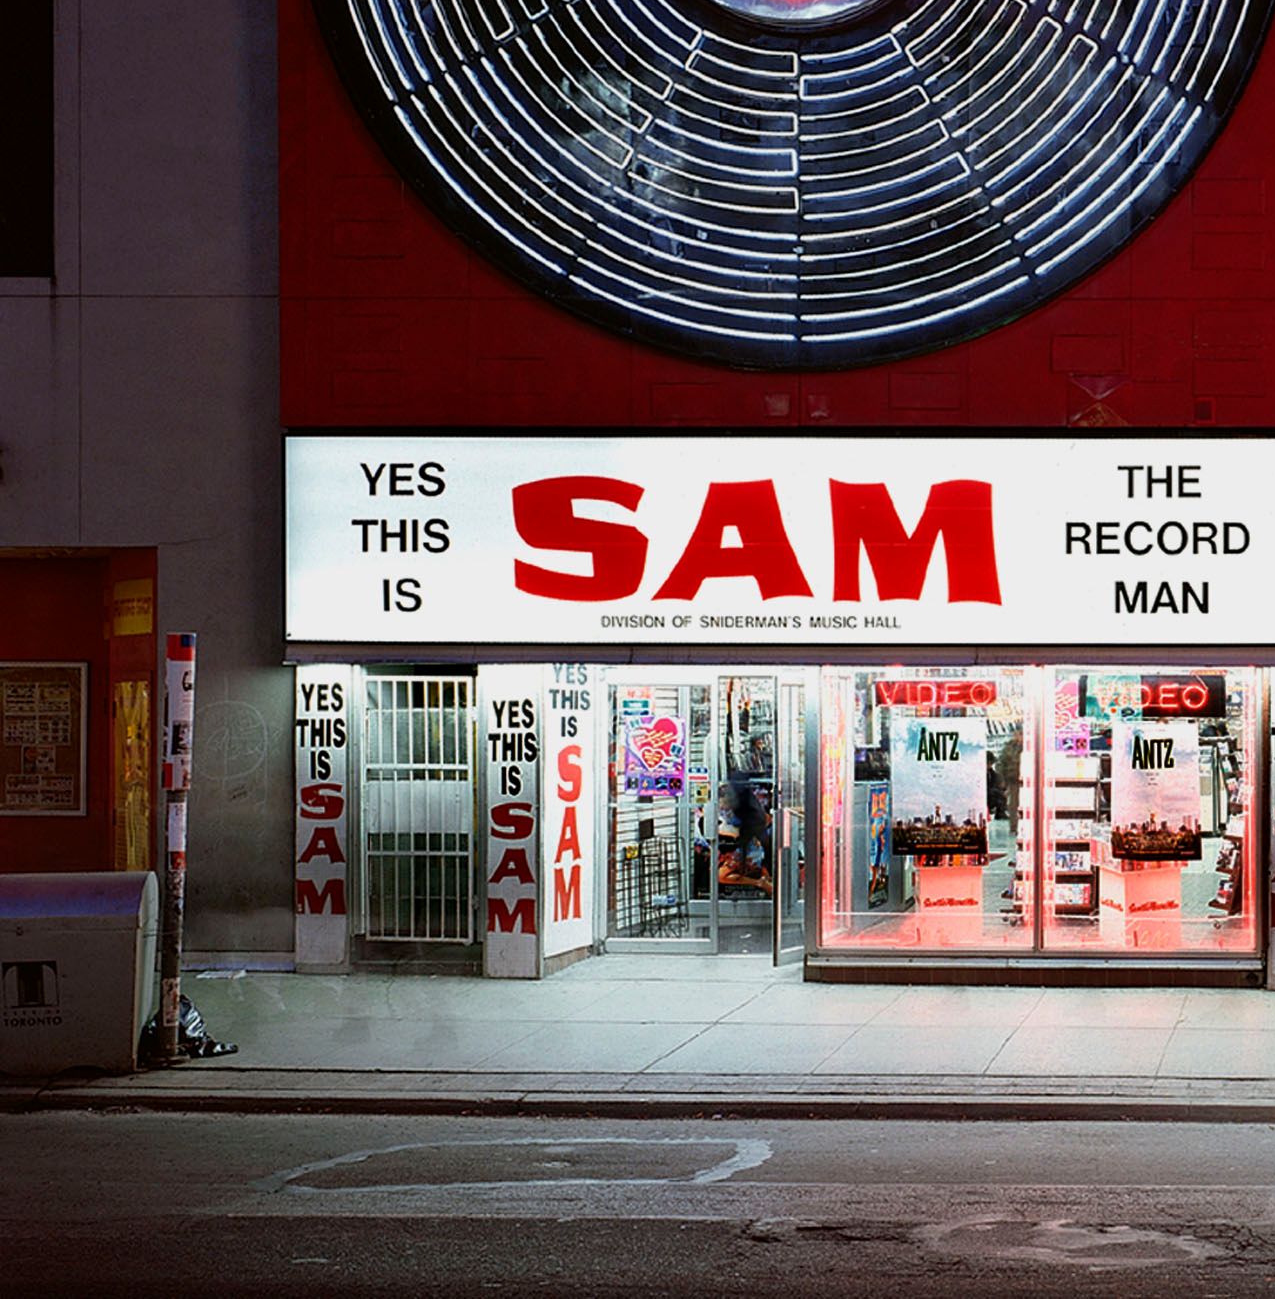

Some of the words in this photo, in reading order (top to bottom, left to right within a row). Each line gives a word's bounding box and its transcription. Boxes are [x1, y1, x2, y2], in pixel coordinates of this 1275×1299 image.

[360, 462, 446, 497] YES
[1118, 465, 1202, 499] THE
[352, 518, 450, 554] THIS
[511, 475, 1003, 605] SAM
[1065, 521, 1251, 556] RECORD
[382, 577, 423, 613] IS
[1114, 580, 1209, 615] MAN
[600, 615, 665, 629] DIVISION
[671, 615, 692, 629] OF
[699, 615, 802, 629] SNIDERMAN'S
[809, 615, 858, 629] MUSIC
[864, 615, 901, 629] HALL
[552, 663, 588, 685] YES
[301, 683, 344, 712] YES
[548, 688, 591, 710] THIS
[878, 682, 994, 706] VIDEO
[492, 699, 534, 729] YES
[560, 716, 578, 738] IS
[296, 718, 347, 748] THIS
[487, 732, 539, 762] THIS
[916, 726, 960, 762] ANTZ
[310, 750, 332, 781] IS
[1131, 736, 1175, 770] ANTZ
[501, 766, 522, 796] IS
[296, 783, 346, 915] SAM
[553, 744, 582, 923] SAM
[487, 801, 537, 935] SAM
[4, 1016, 63, 1027] TORONTO
